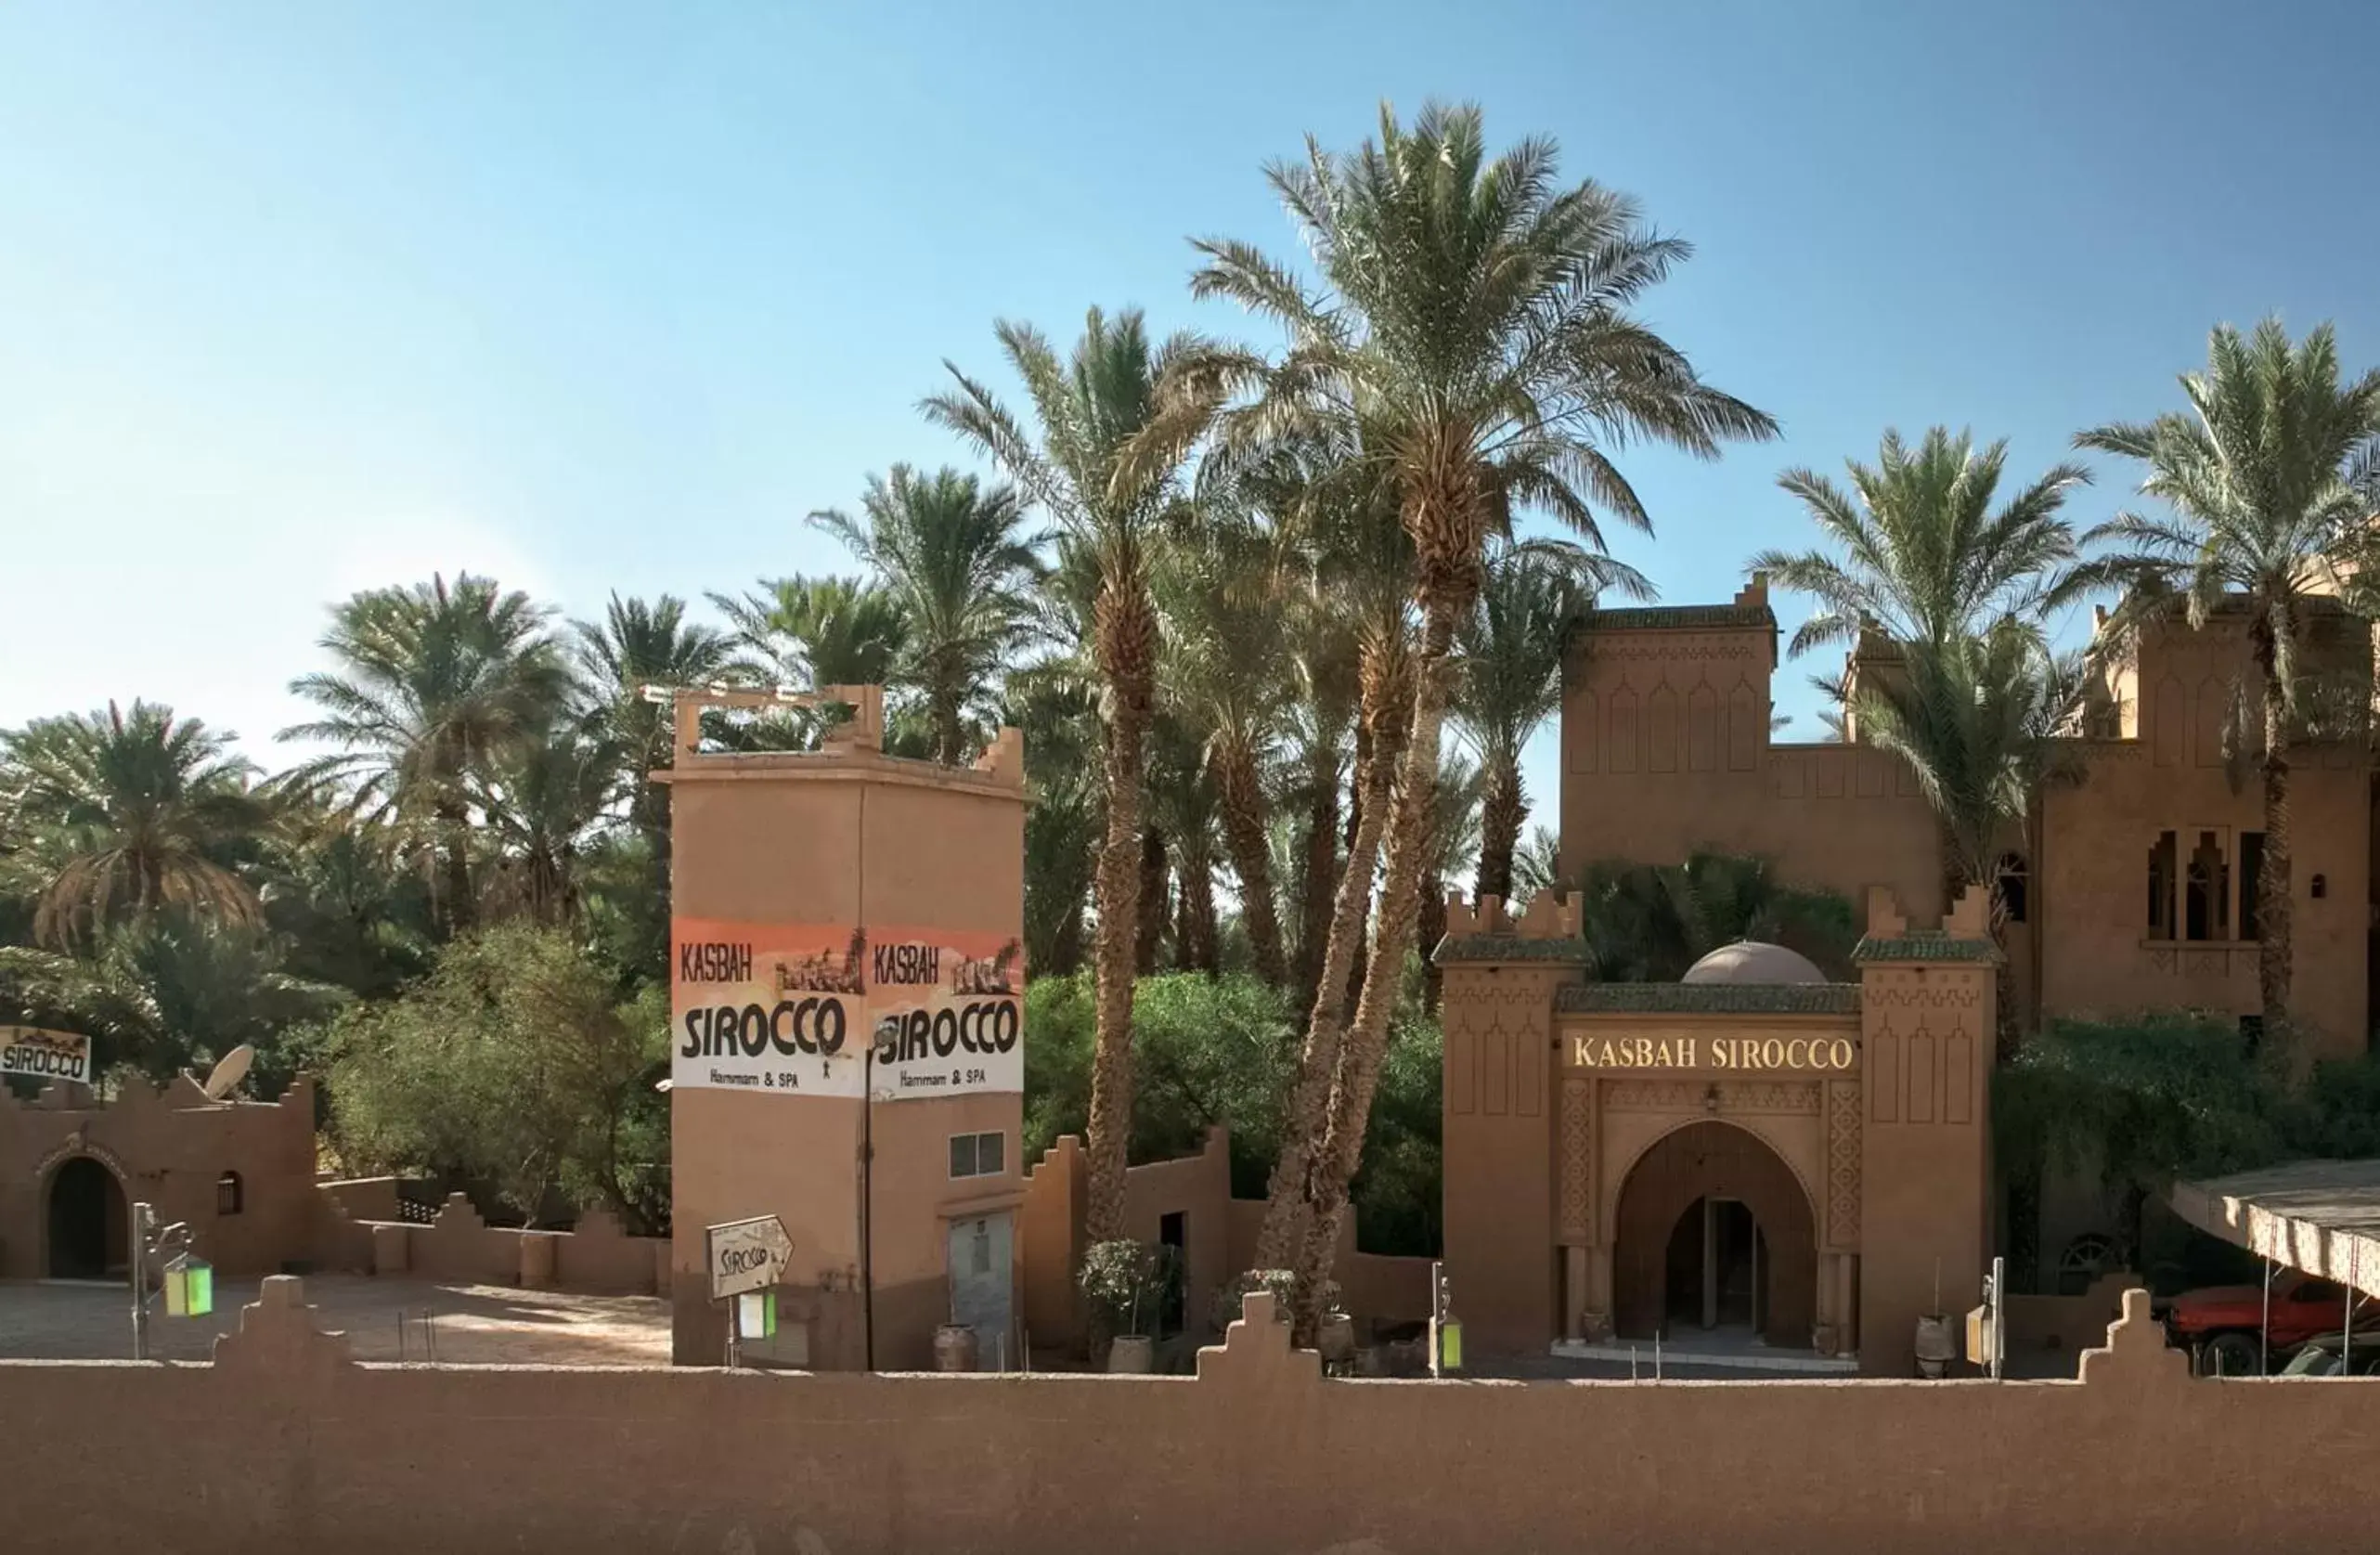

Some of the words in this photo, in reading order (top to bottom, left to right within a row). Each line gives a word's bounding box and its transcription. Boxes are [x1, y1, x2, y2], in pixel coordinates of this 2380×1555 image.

[680, 942, 752, 983] KASBAH
[873, 944, 939, 985] KASBAH
[680, 996, 847, 1058] SIROCCO
[878, 999, 1018, 1065] SIROCCO
[3, 1045, 85, 1079] SIROCCO
[1573, 1036, 1697, 1068] KASBAH
[1711, 1037, 1854, 1069] SIROCCO
[709, 1068, 759, 1086] Hammam
[764, 1071, 774, 1087] &
[778, 1071, 799, 1088] SPA
[899, 1069, 947, 1089] Hammam
[951, 1069, 962, 1085] &
[965, 1069, 987, 1084] SPA
